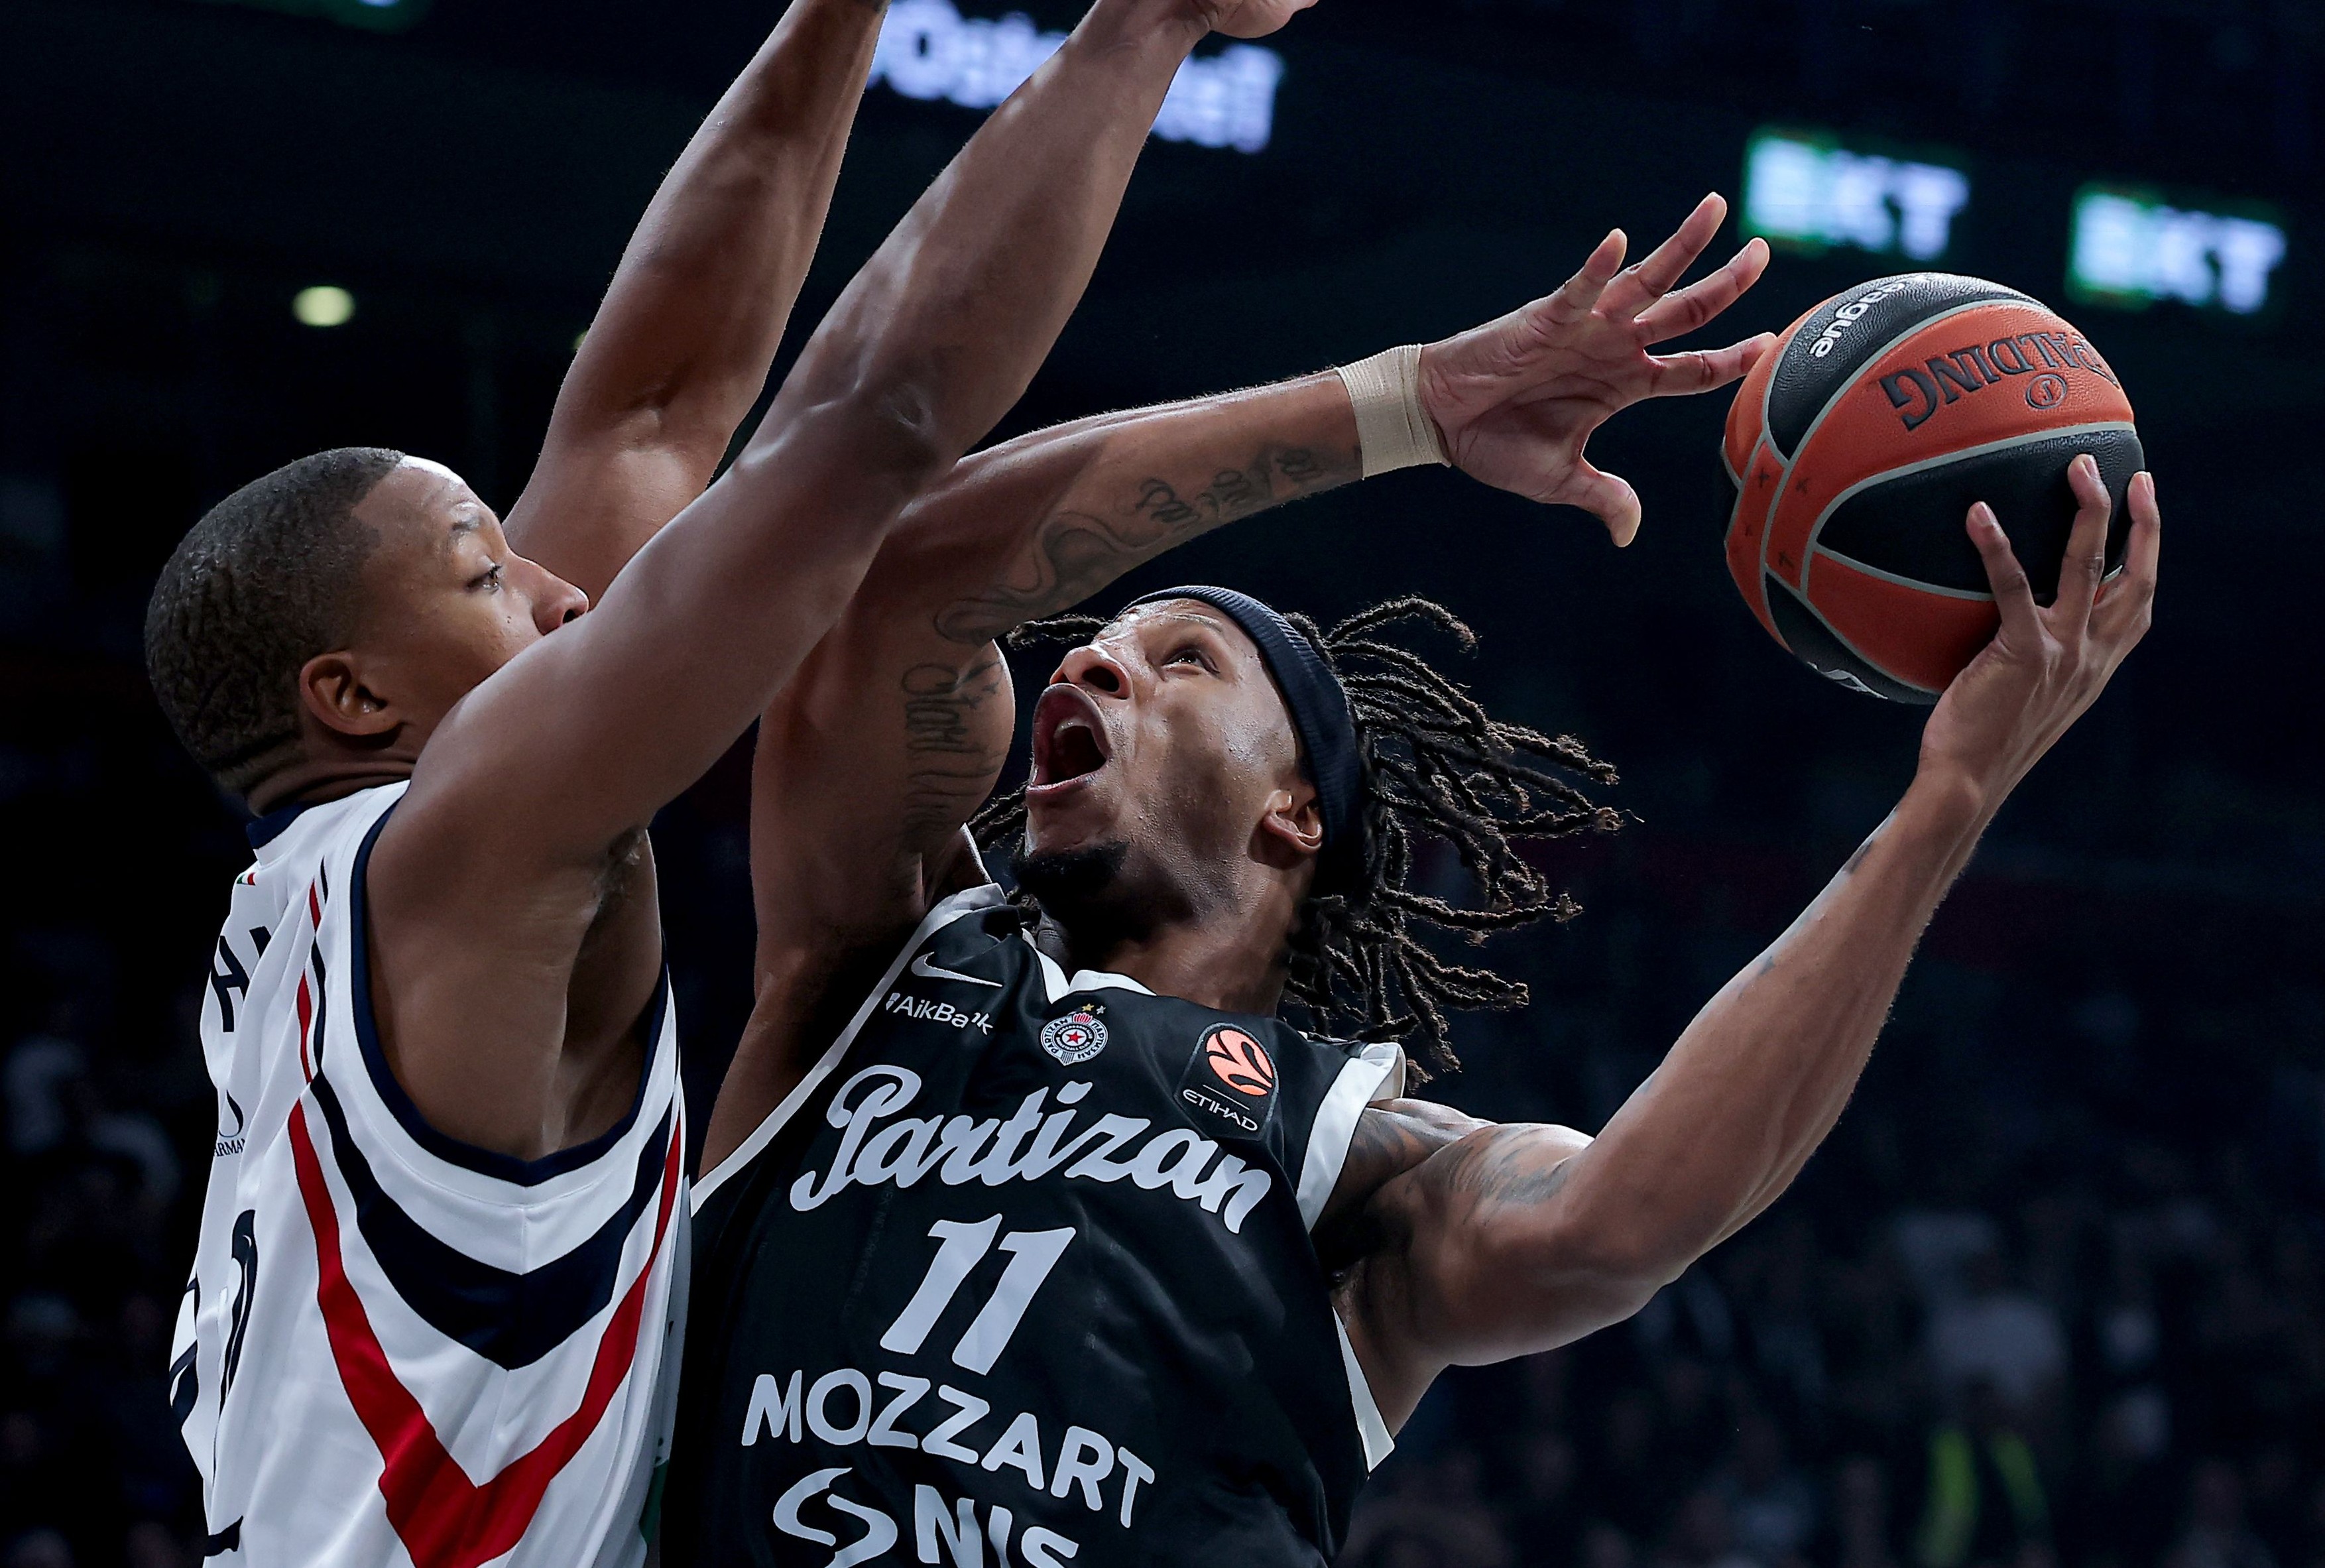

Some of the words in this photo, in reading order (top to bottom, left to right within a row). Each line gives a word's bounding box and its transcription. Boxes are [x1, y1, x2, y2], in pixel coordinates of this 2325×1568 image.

[790, 1064, 1272, 1234] Partizan
[1182, 1089, 1258, 1131] ETIHAD
[879, 1213, 1077, 1375] 11
[741, 1368, 1155, 1529] MOZZART
